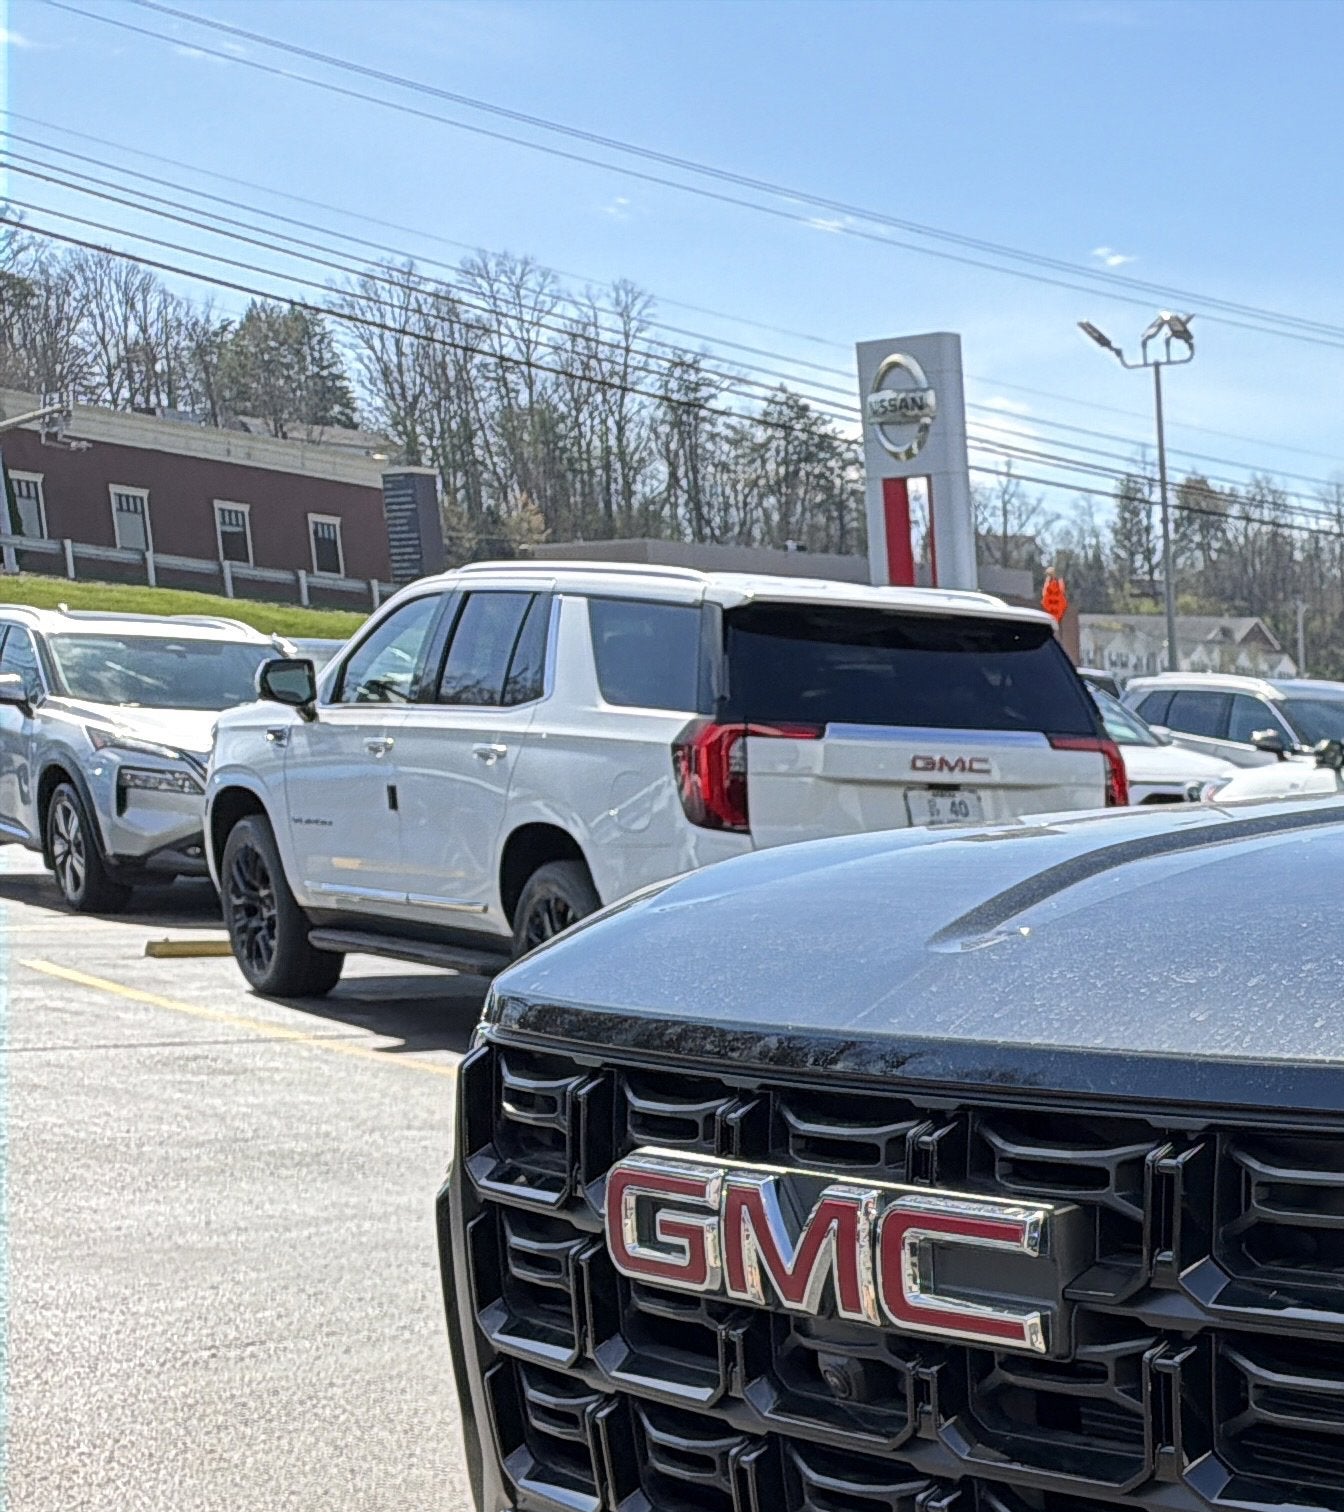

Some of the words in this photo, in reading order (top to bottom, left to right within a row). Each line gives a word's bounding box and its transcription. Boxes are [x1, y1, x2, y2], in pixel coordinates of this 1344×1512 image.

[868, 396, 925, 416] NISSAN
[910, 754, 992, 775] GMC
[605, 1153, 1050, 1356] GMC
